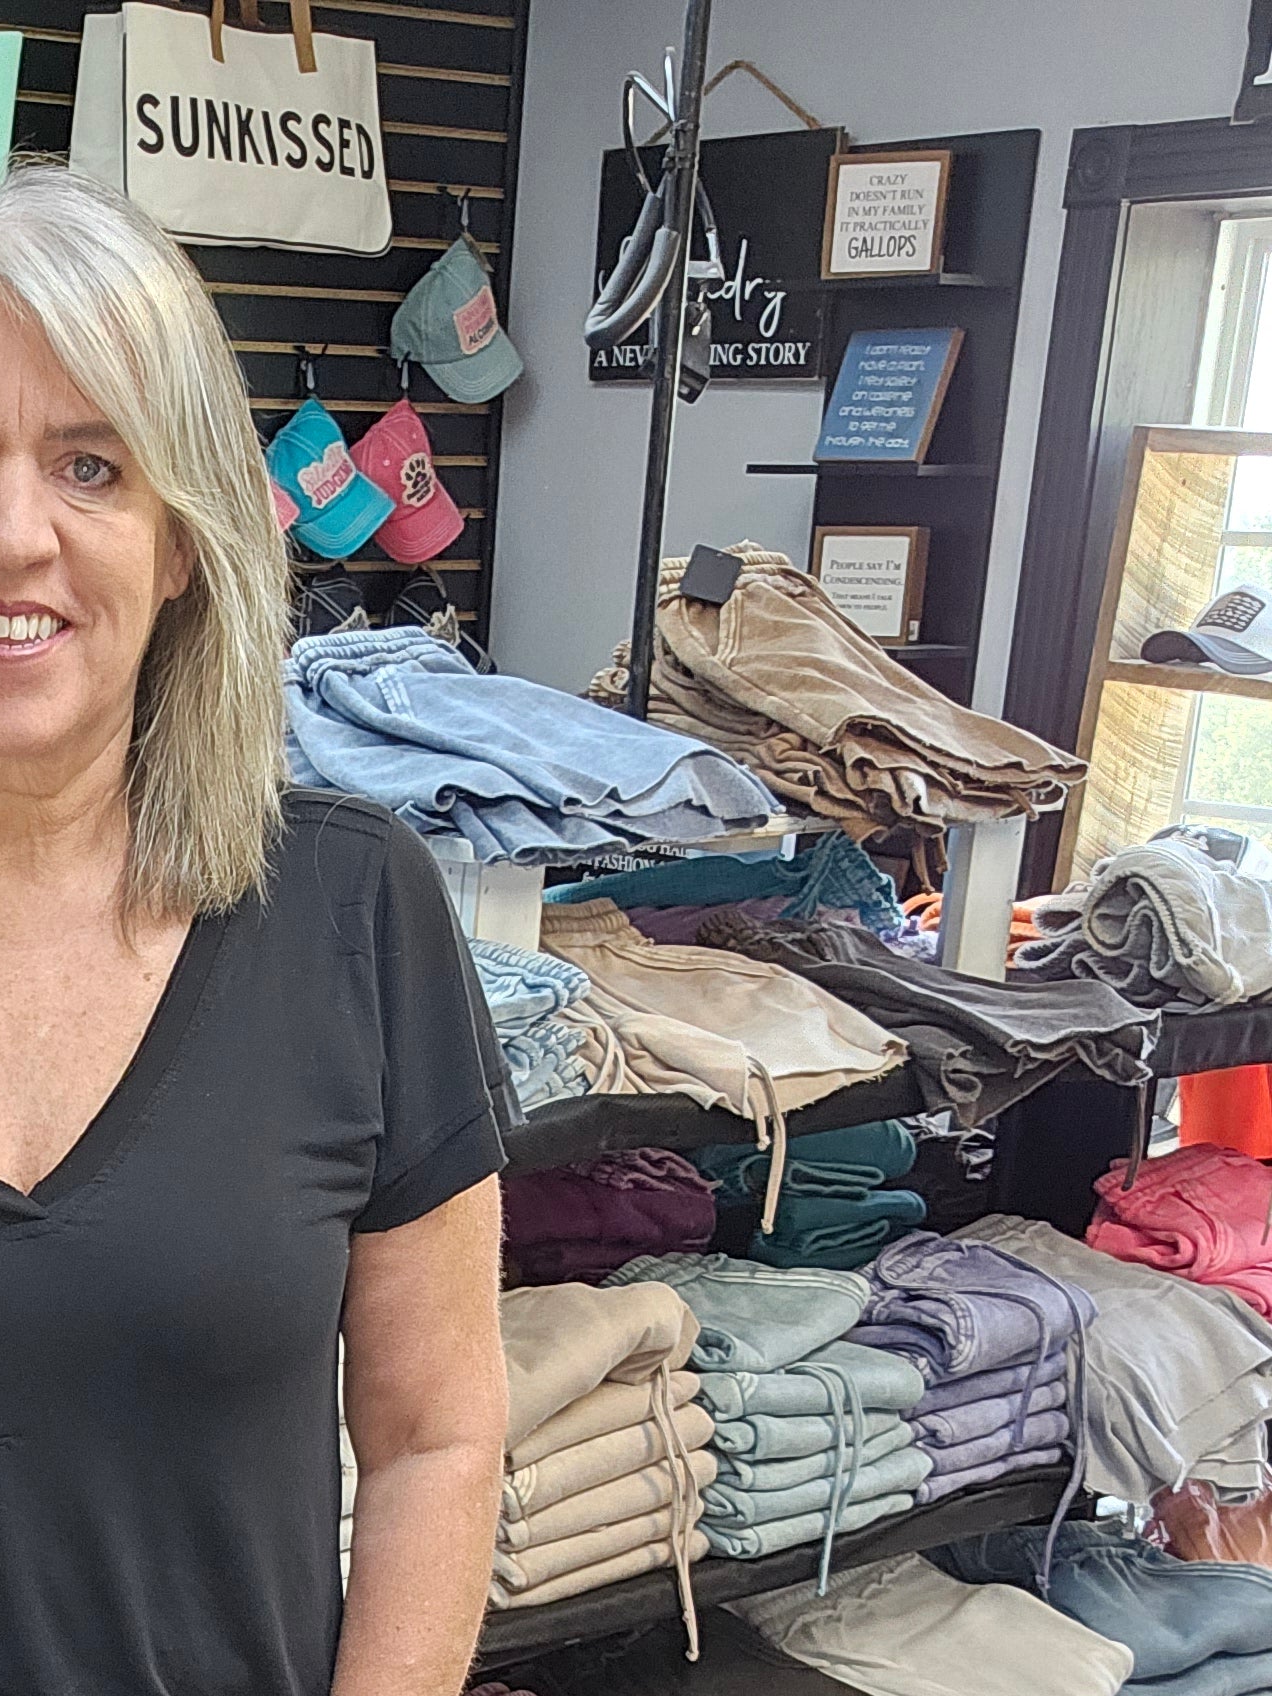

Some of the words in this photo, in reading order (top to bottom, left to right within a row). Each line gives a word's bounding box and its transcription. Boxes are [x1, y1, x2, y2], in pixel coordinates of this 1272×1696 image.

[136, 93, 375, 180] SUNKISSED
[869, 174, 909, 186] CRAZY
[850, 190, 897, 202] DOESN'T
[900, 189, 924, 200] RUN
[848, 207, 860, 217] IN
[862, 206, 880, 216] MY
[882, 204, 926, 216] FAMILY
[840, 222, 851, 232] IT
[853, 219, 930, 232] PRACTICALLY
[848, 234, 916, 259] GALLOPS
[594, 350, 608, 367] A
[746, 342, 811, 365] STORY
[830, 560, 864, 570] PEOPLE
[866, 562, 883, 570] SAY
[886, 560, 901, 571] I'M
